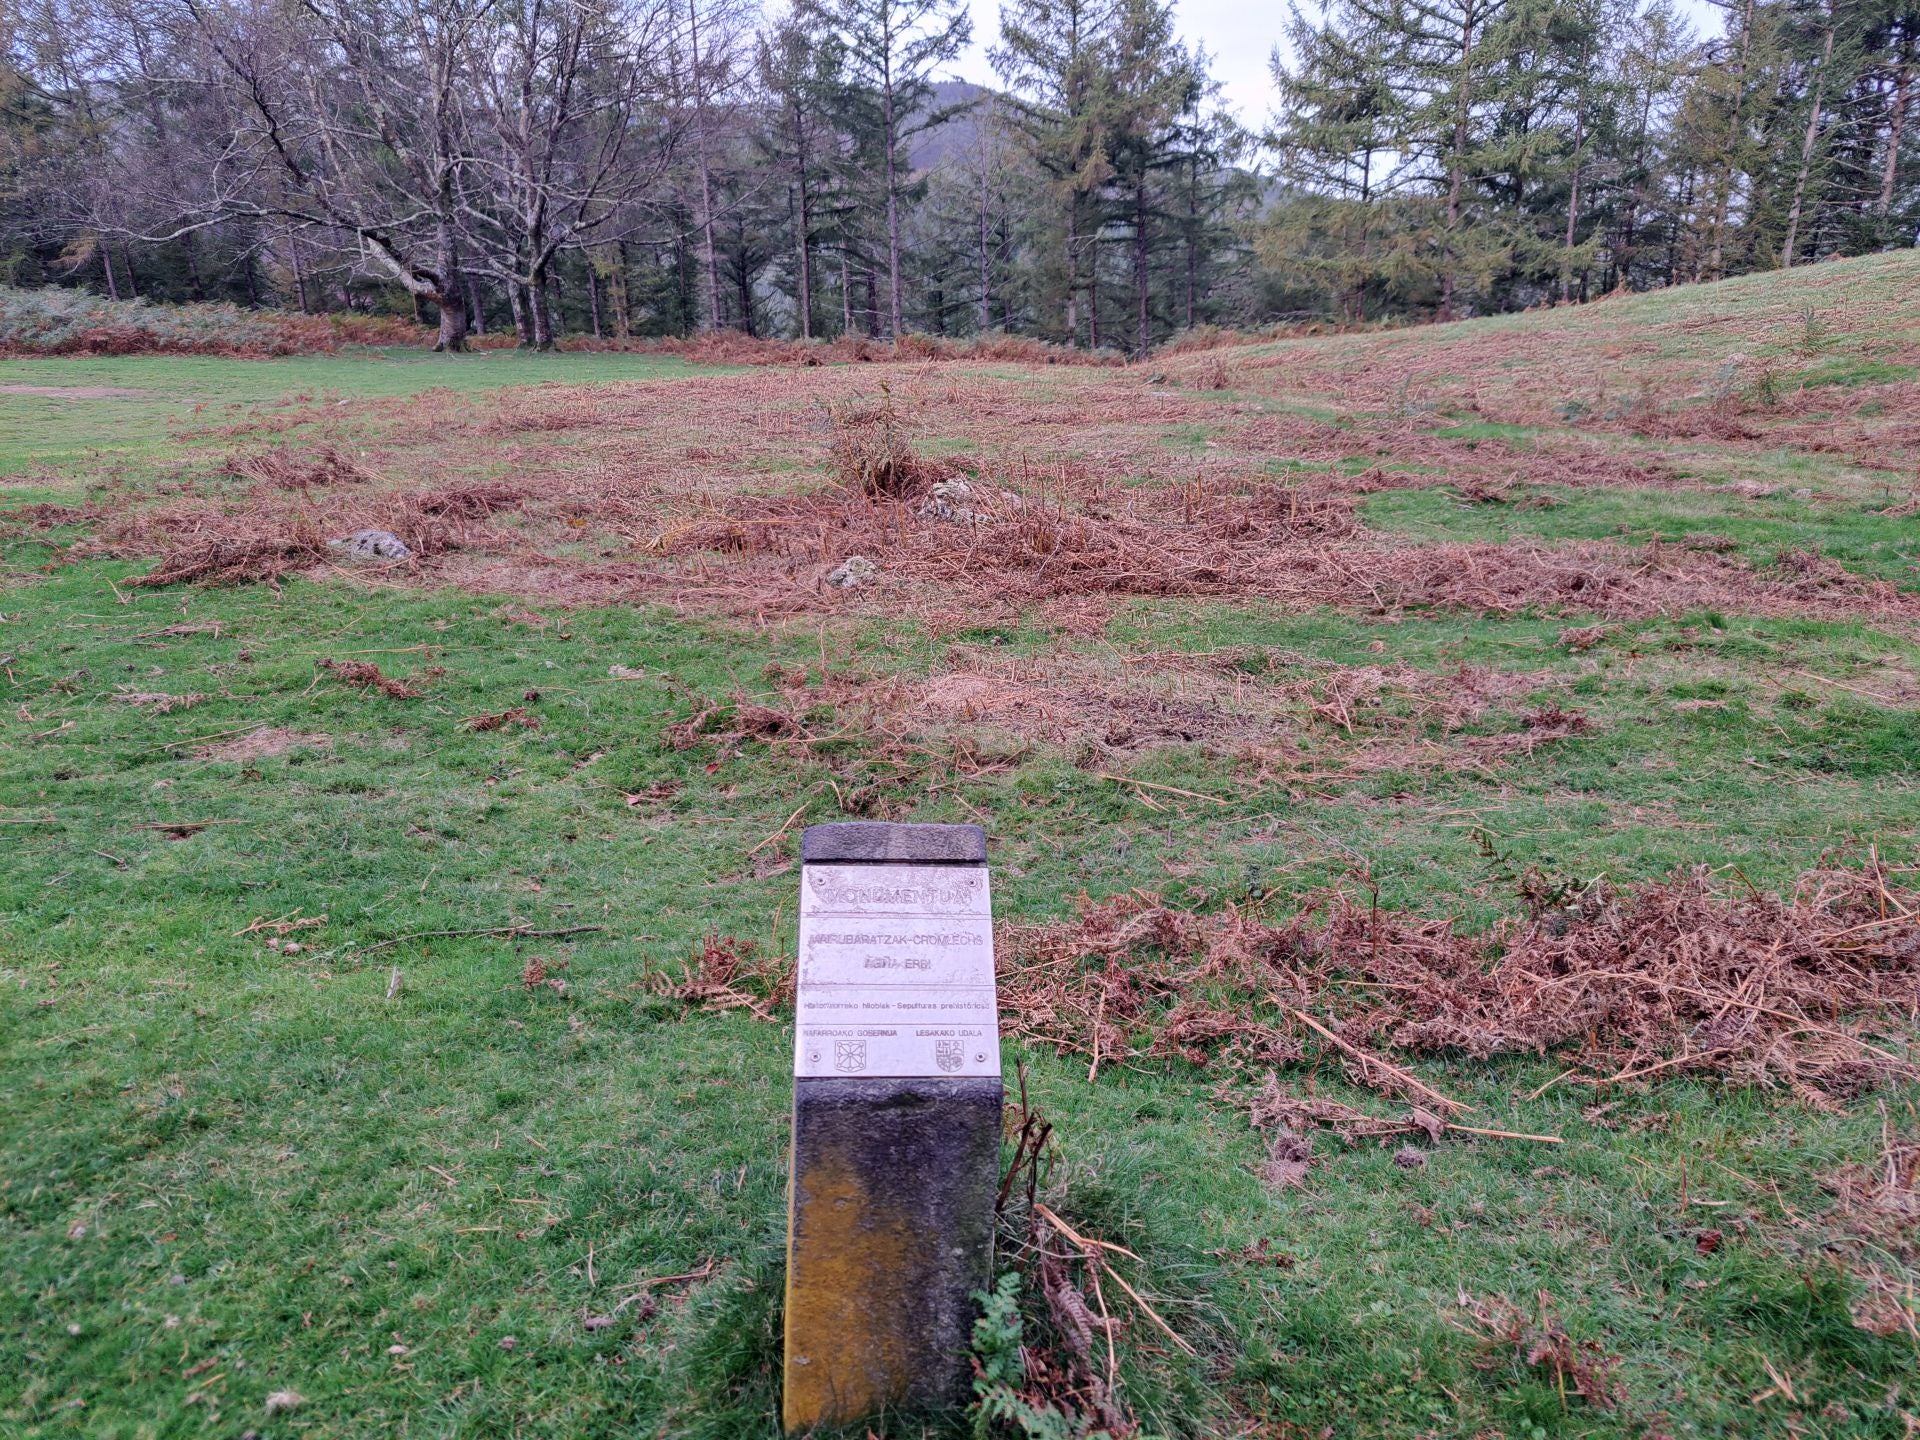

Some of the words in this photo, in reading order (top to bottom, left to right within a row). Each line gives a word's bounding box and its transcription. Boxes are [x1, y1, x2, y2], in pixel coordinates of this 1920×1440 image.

[824, 888, 973, 904] MONUMENTUA
[915, 1029, 955, 1037] LESAKAKO
[958, 1029, 982, 1037] UDALA
